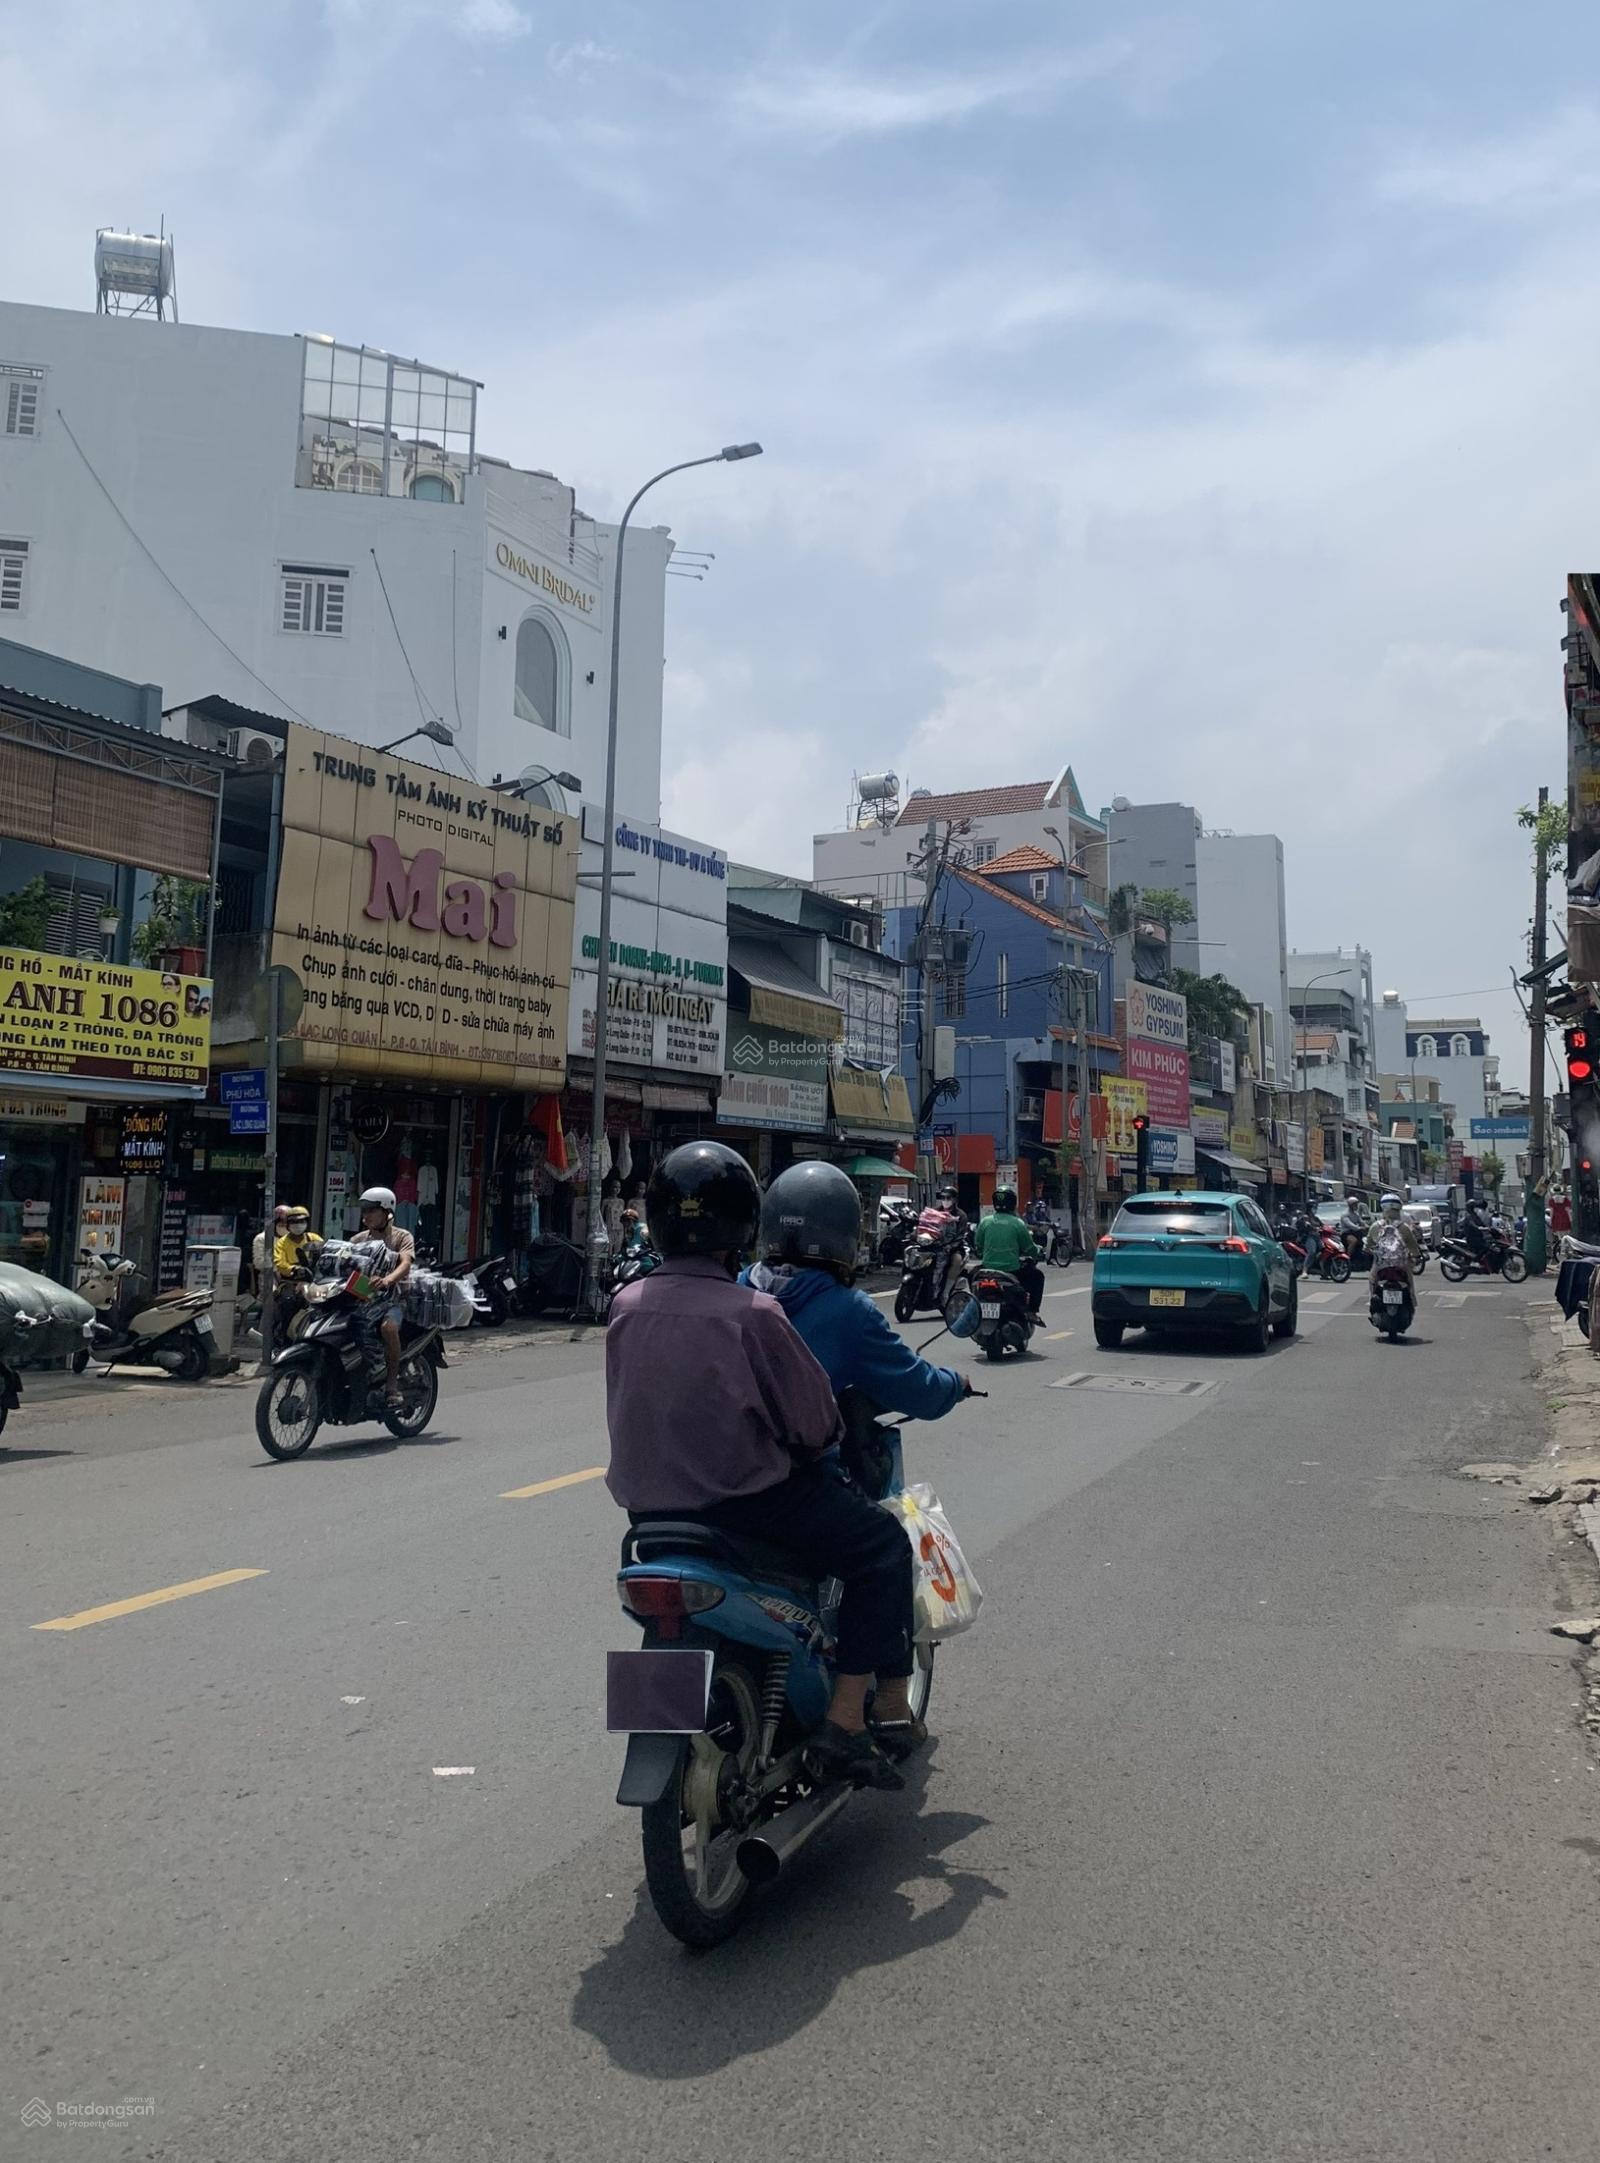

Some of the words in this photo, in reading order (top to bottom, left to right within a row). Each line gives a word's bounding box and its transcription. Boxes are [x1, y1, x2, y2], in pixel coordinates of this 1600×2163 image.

[496, 542, 539, 585] OMNI
[313, 751, 376, 787] TRUNG
[386, 773, 422, 802] TÂM
[426, 782, 461, 813] ẢNH
[491, 808, 540, 839] THUẬT
[543, 821, 563, 845] SỐ
[397, 810, 443, 832] PHOTO
[448, 824, 494, 846] DIGITAL
[615, 822, 639, 851] CÔNG
[640, 835, 651, 855] TY
[363, 834, 518, 948] Mai
[297, 923, 309, 941] In
[313, 926, 339, 947] ảnh
[342, 935, 357, 951] từ
[359, 937, 383, 955] các
[387, 941, 409, 963] loại
[412, 949, 443, 969] card,
[445, 954, 463, 971] đĩa
[473, 960, 499, 978] Phục
[521, 968, 540, 986] ảnh
[542, 975, 555, 990] cũ
[97, 969, 133, 988] KÍNH
[302, 955, 337, 978] Chụp
[341, 958, 366, 984] ảnh
[370, 968, 397, 988] cưới
[407, 975, 436, 994] chân
[440, 983, 472, 1002] dung,
[475, 987, 495, 1005] thời
[499, 994, 525, 1014] trang
[528, 998, 552, 1018] baby
[3, 980, 87, 1017] ANH
[99, 992, 180, 1030] 1086
[302, 988, 327, 1009] ang
[331, 989, 362, 1015] băng
[366, 999, 389, 1016] qua
[394, 1000, 422, 1022] VCD,
[461, 1012, 480, 1029] sửa
[483, 1016, 509, 1033] chữa
[513, 1022, 534, 1041] máy
[537, 1023, 555, 1040] ảnh
[1145, 991, 1183, 1018] YOSHINO
[59, 1021, 69, 1032] 2
[133, 1030, 153, 1042] ĐA
[322, 1026, 348, 1042] LONG
[1146, 1015, 1184, 1039] GYPSUM
[31, 1034, 66, 1049] LÀM
[71, 1039, 110, 1054] THEO
[114, 1044, 142, 1057] TOA
[147, 1047, 175, 1061] BÁC
[147, 1066, 167, 1078] 0903
[168, 1068, 184, 1079] 835
[1131, 1048, 1151, 1070] KIM
[1155, 1051, 1185, 1076] PHÚC
[226, 1087, 242, 1100] PHÚ
[126, 1112, 150, 1132] ĐỒNG
[151, 1109, 164, 1132] HỒ
[124, 1135, 142, 1156] MẮT
[143, 1138, 163, 1157] KÍNH
[1153, 1139, 1177, 1155] YOSHINO
